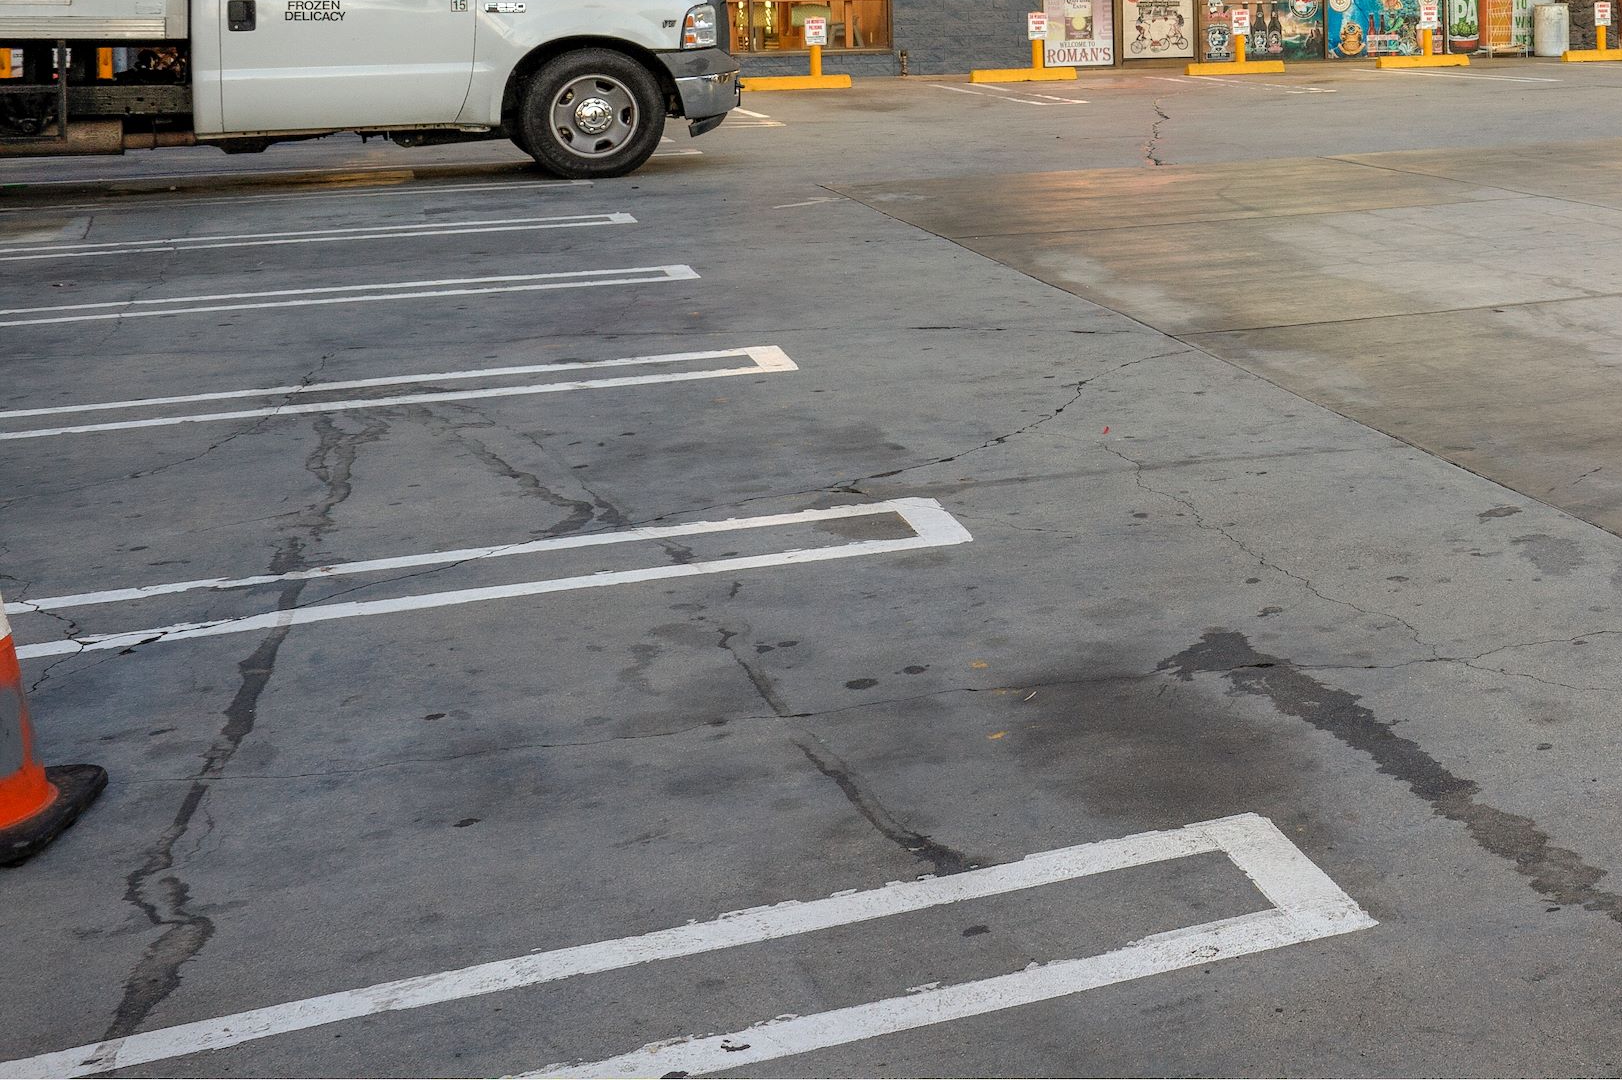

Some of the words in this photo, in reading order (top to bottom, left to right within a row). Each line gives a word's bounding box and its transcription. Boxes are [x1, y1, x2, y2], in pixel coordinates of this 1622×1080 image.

[287, 0, 341, 11] FROZEN
[453, 0, 466, 11] 15
[284, 11, 346, 21] DELICACY
[1449, 0, 1479, 26] IPA
[1047, 47, 1112, 63] ROMAN'S
